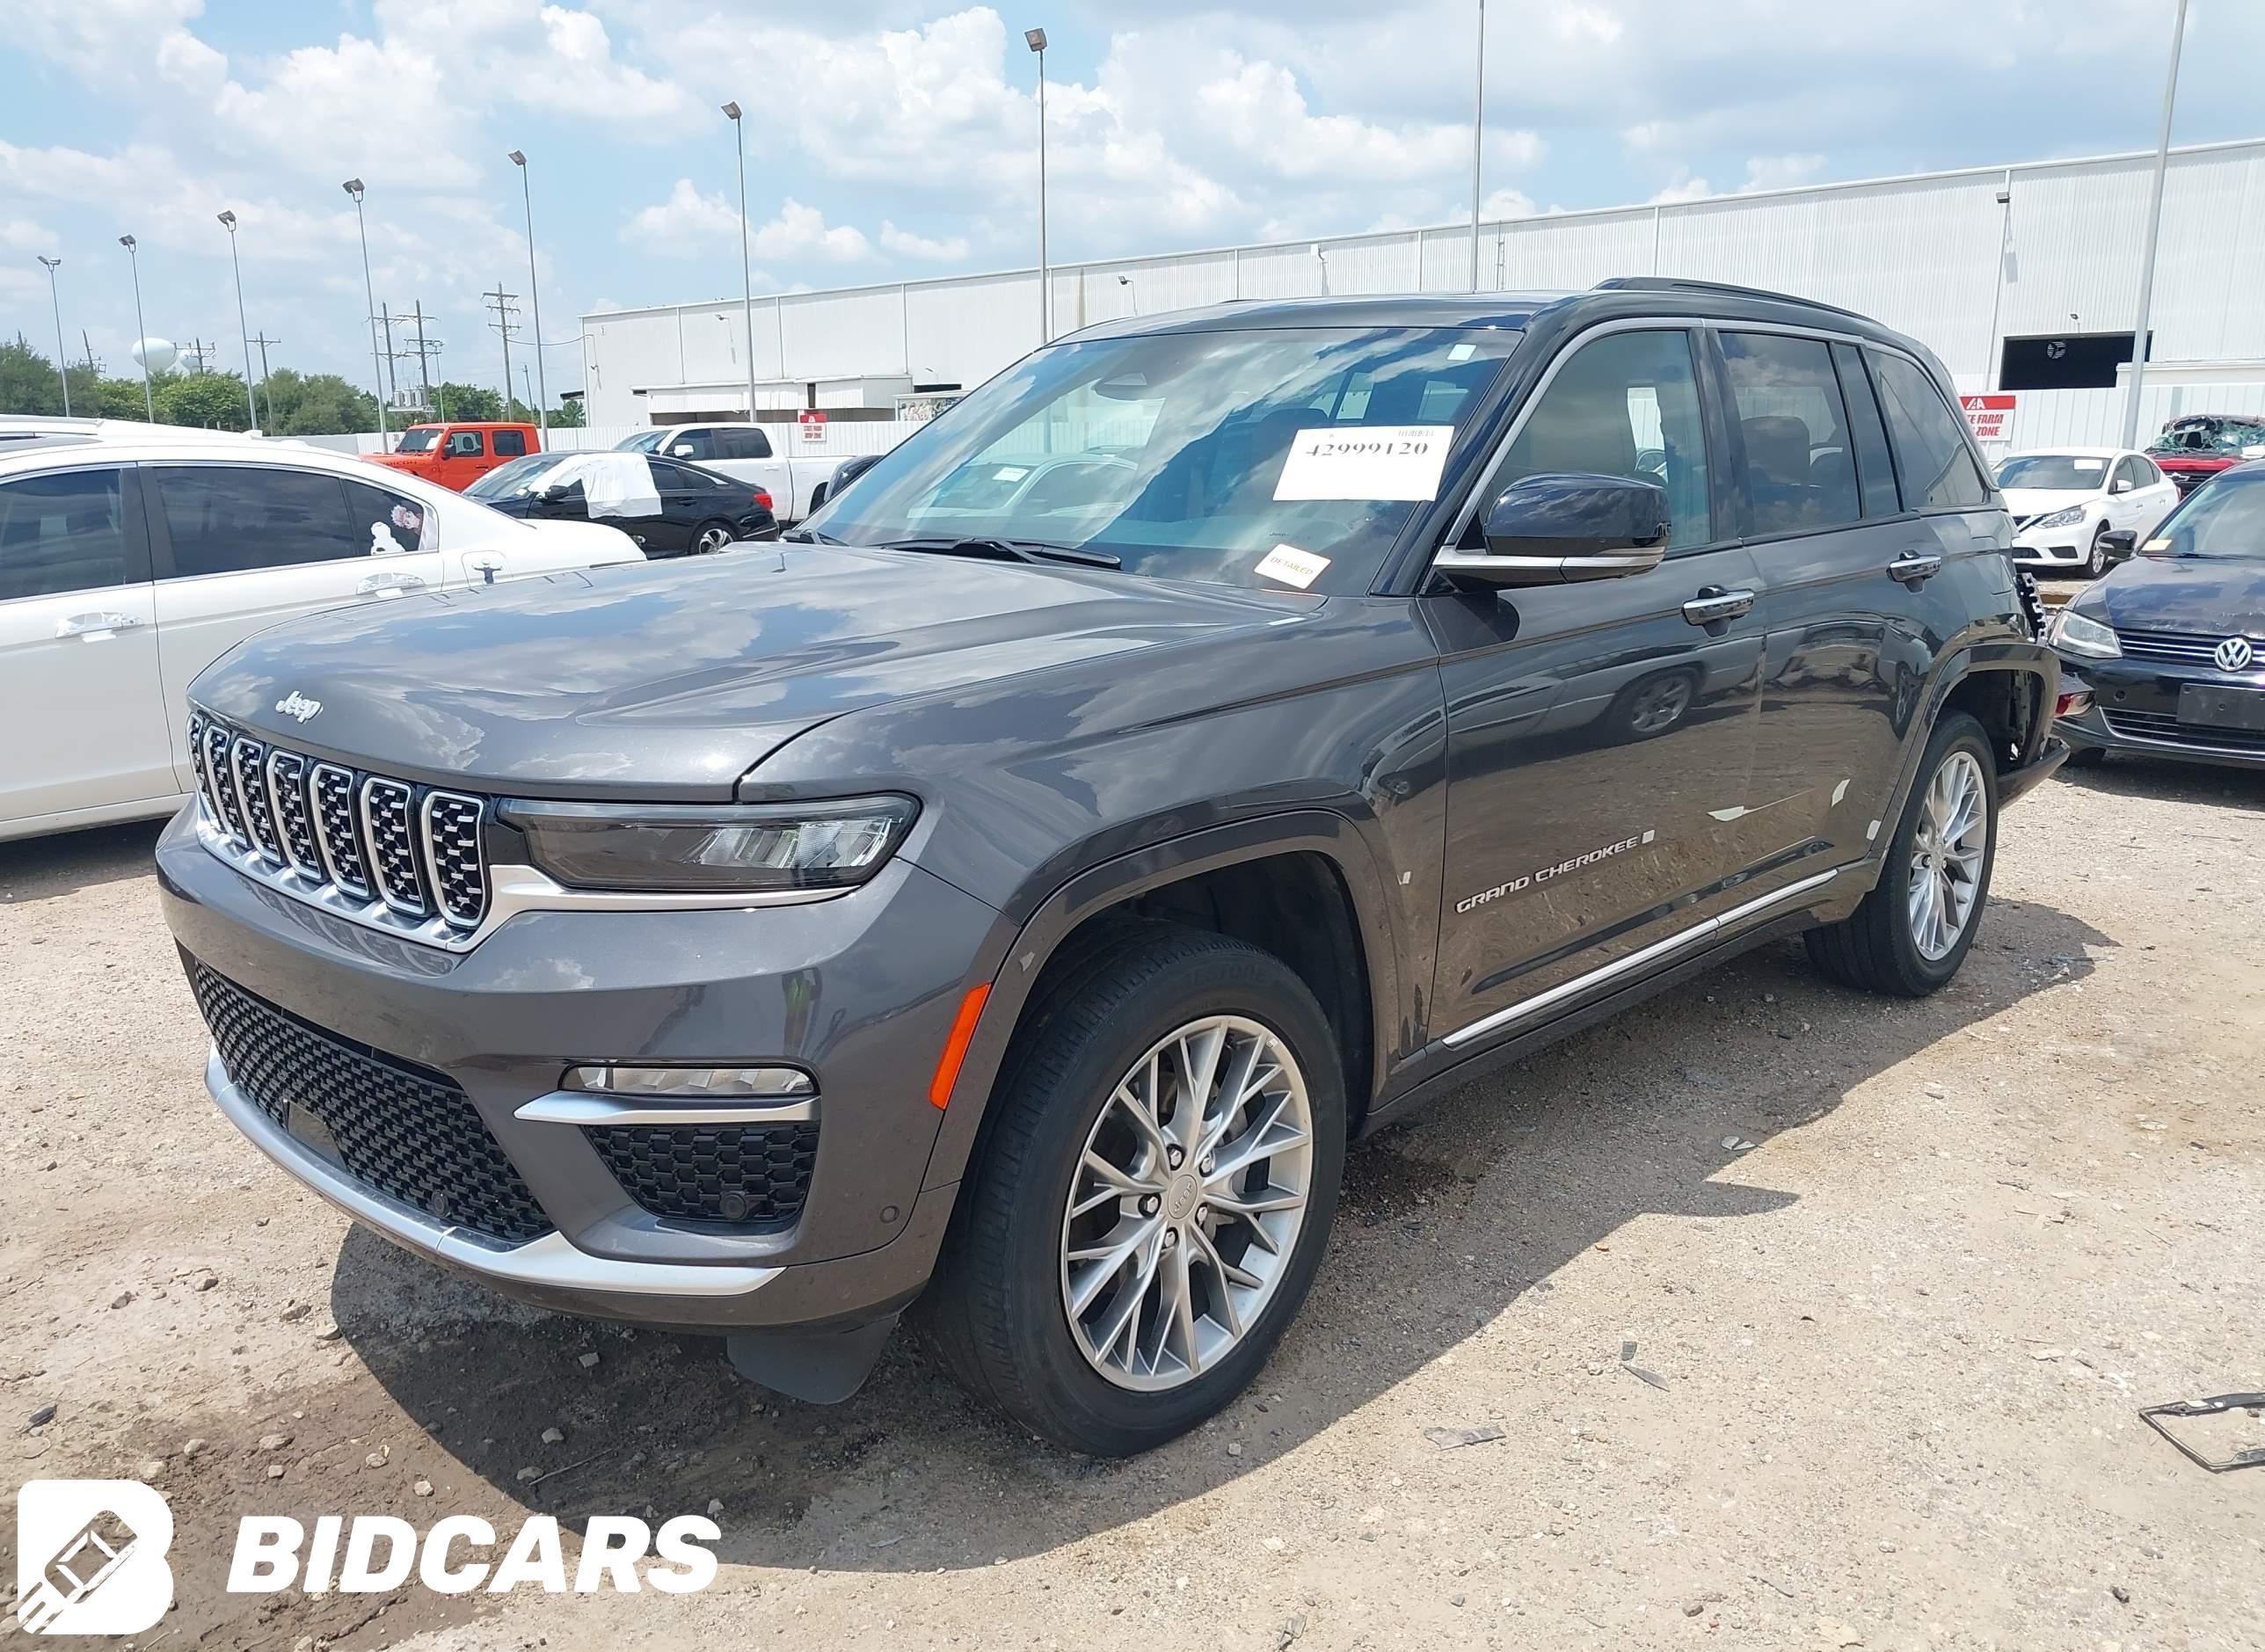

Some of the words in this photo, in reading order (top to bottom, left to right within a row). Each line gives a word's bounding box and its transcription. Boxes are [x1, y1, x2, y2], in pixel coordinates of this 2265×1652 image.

[1977, 414, 2004, 424] FARM
[1976, 426, 2000, 436] ZONE
[1306, 442, 1429, 456] 42999120
[275, 690, 324, 724] Jeep
[1456, 877, 1530, 913] GRAND
[1534, 836, 1638, 883] CHEROKEE
